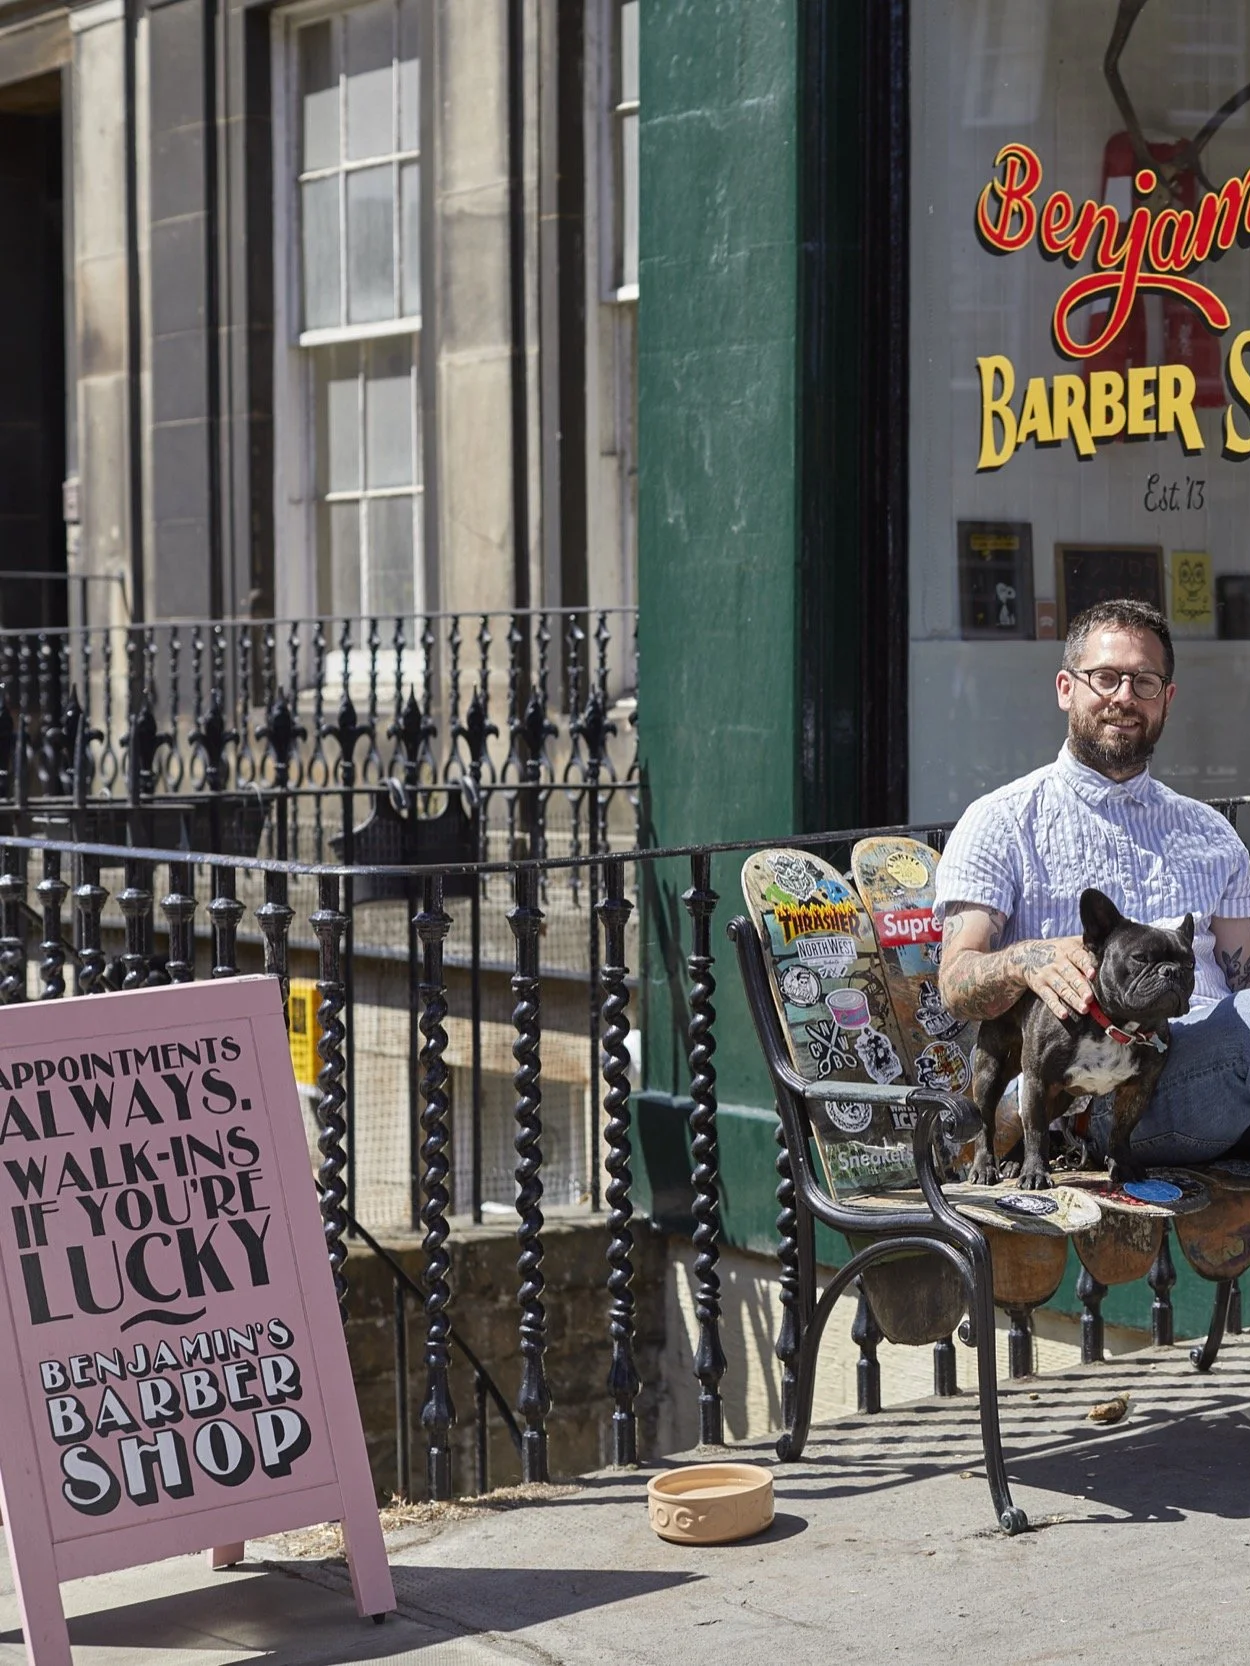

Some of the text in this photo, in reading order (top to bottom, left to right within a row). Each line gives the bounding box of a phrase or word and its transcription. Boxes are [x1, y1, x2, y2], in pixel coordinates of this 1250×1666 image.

[976, 354, 1206, 472] BARBER
[775, 901, 864, 947] THRASHER
[0, 1068, 252, 1145] ALWAYS.
[3, 1125, 260, 1200] WALK-INS
[11, 1168, 271, 1249] IF YOU'RE
[20, 1214, 271, 1325] LUCKY
[39, 1318, 295, 1395] BENJAMIN'S
[46, 1354, 303, 1445] BARBER
[62, 1405, 312, 1517] SHOP
